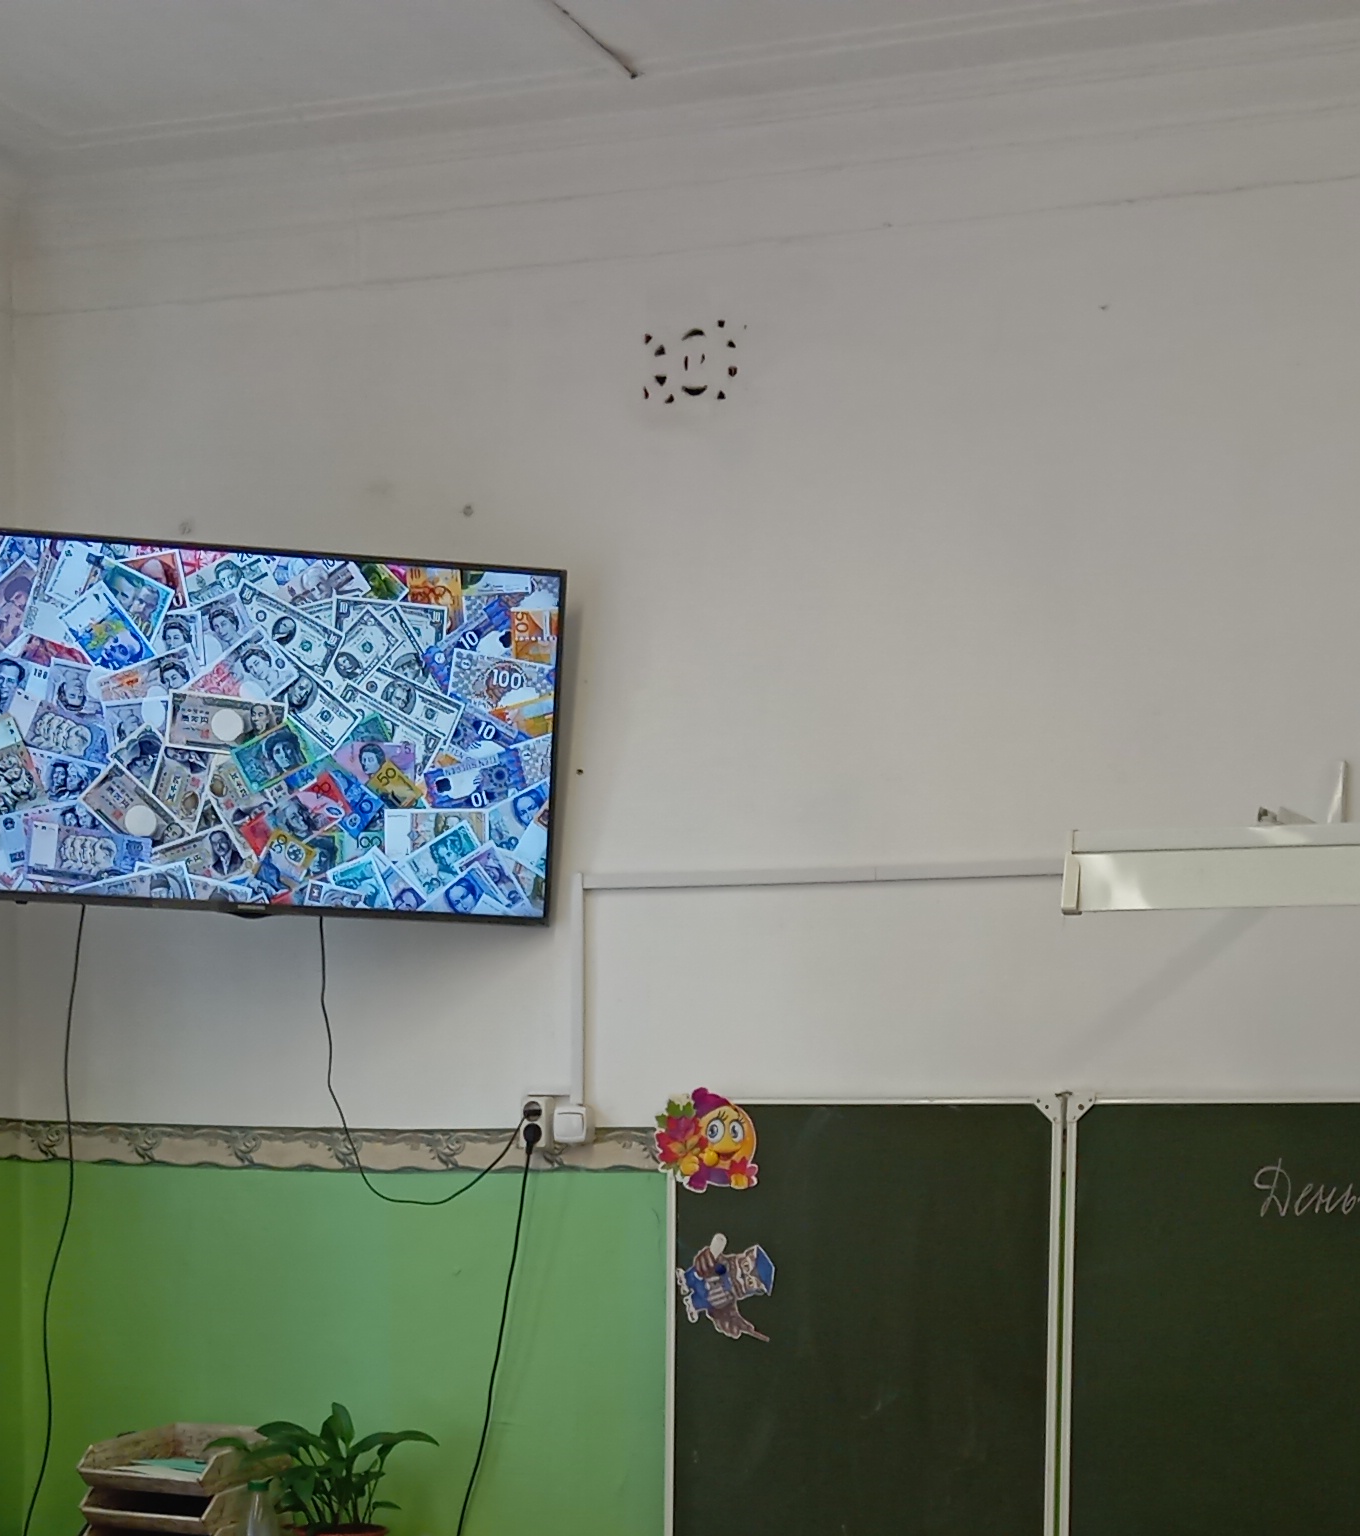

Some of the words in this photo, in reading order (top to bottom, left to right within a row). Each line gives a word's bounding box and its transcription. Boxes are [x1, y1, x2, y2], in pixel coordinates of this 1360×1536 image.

[459, 631, 479, 650] 10
[492, 668, 522, 690] 100
[477, 721, 496, 740] 10
[377, 767, 397, 786] 50
[269, 833, 288, 854] 50
[356, 835, 382, 849] 100
